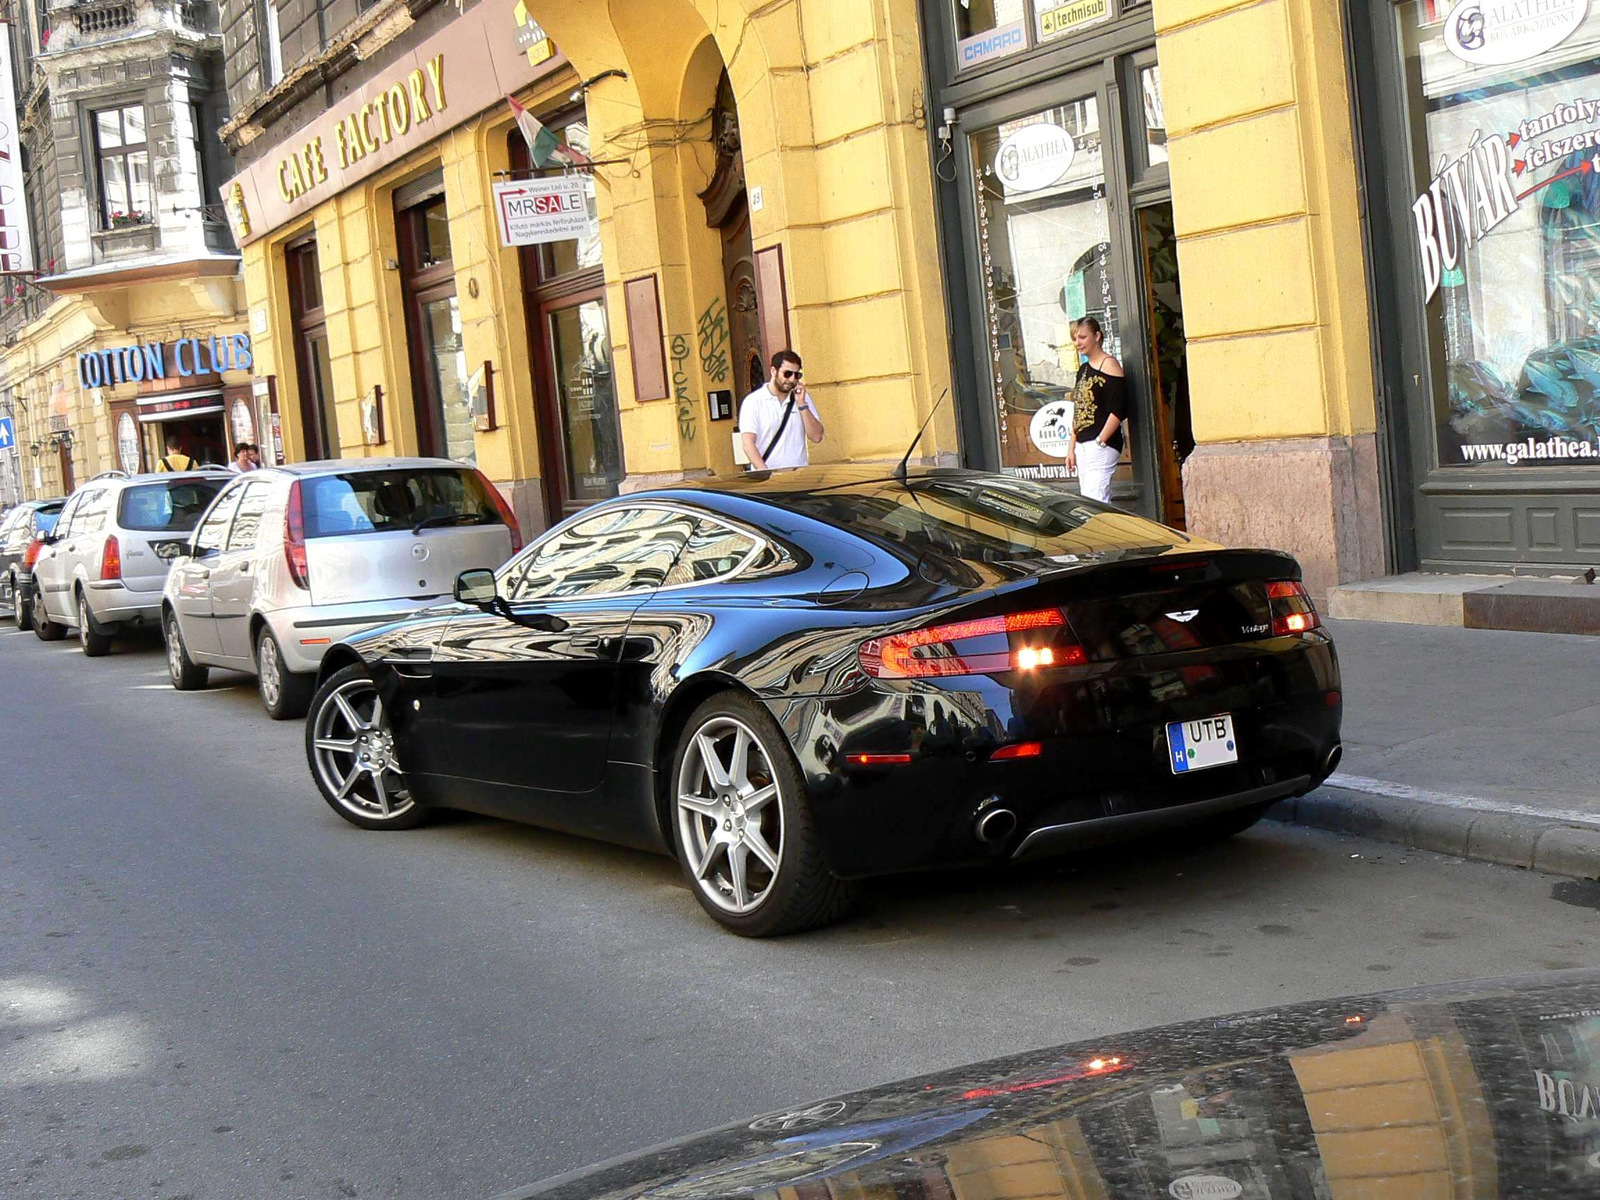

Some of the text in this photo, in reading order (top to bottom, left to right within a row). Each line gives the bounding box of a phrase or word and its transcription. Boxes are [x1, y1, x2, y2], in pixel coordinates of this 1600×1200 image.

[1057, 0, 1105, 27] technisub
[965, 28, 1021, 60] CAMARO
[277, 53, 447, 203] CAFE FACTORY
[1519, 98, 1600, 142] tanfoly
[508, 194, 580, 217] MRSALE
[1412, 128, 1519, 305] BÚVÁR
[77, 333, 252, 390] COTTON CLUB
[1460, 436, 1600, 465] www.galathea.
[1189, 719, 1227, 743] UTB
[1175, 751, 1184, 762] H
